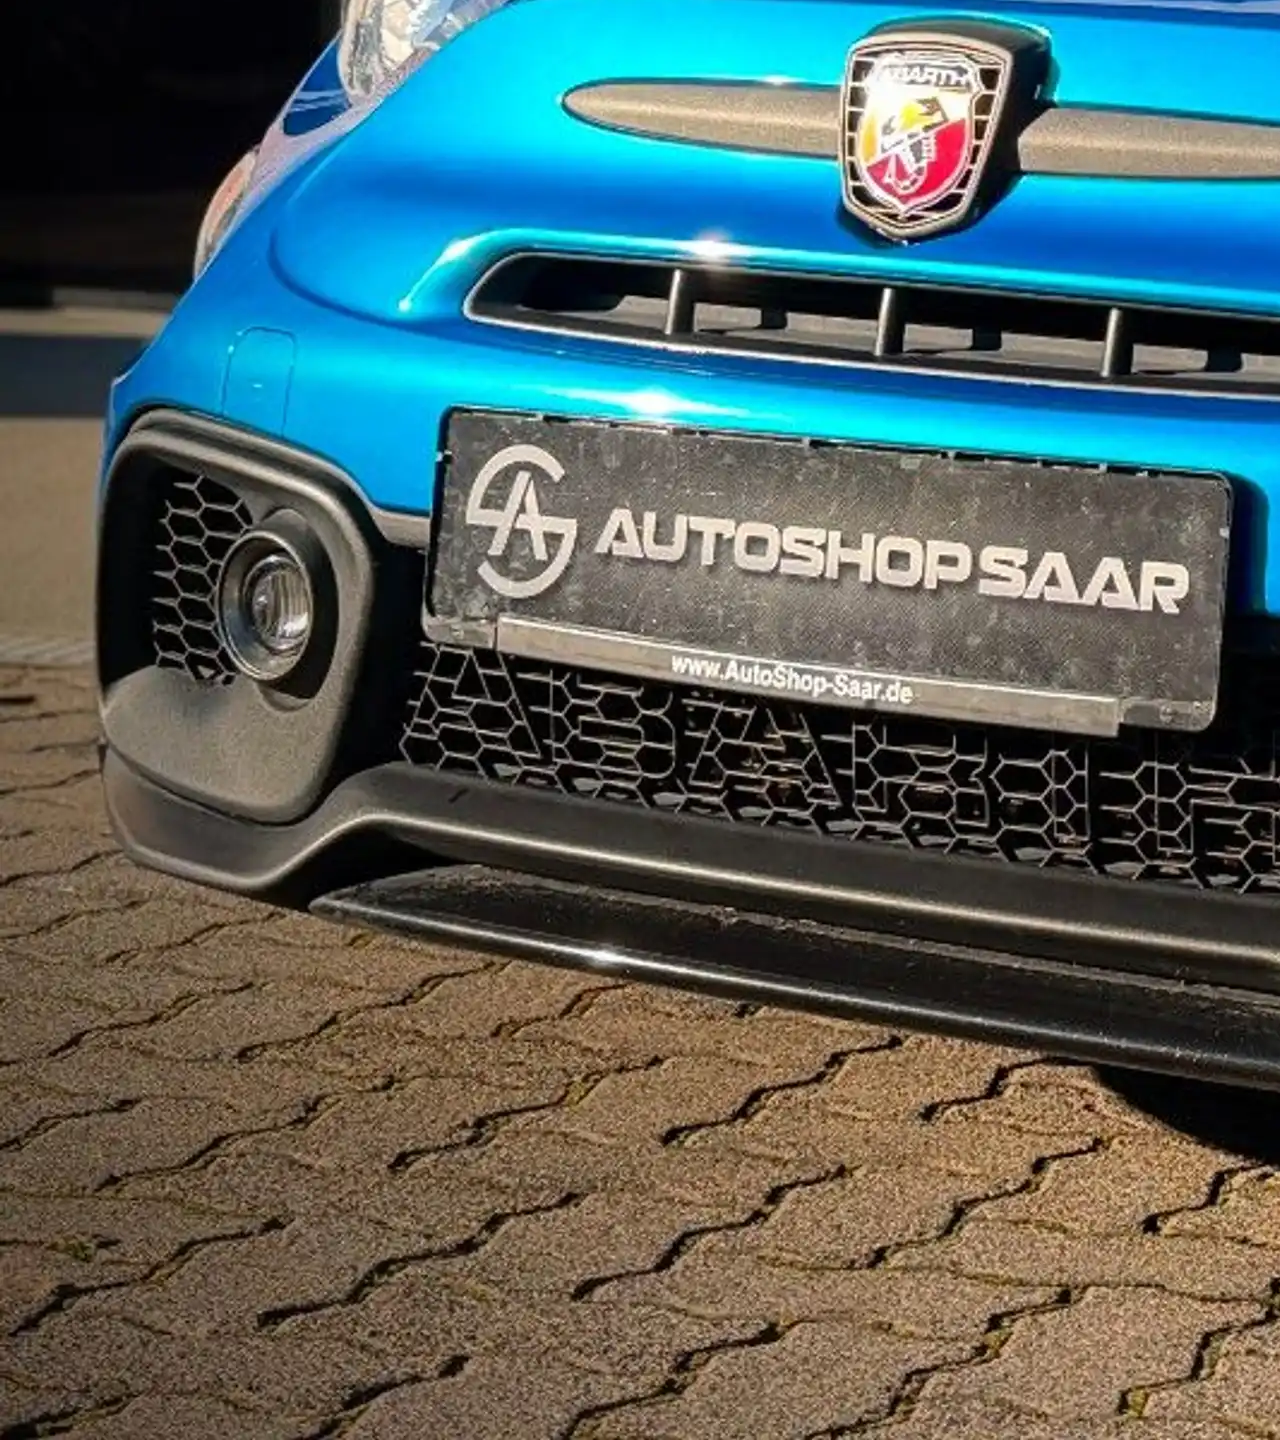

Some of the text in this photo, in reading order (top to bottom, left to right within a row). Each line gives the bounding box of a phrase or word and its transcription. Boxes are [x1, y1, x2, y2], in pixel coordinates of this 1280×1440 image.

[594, 508, 1190, 614] AUTOSHOP SAAR
[671, 655, 914, 705] www.AutoShop-Saar.de
